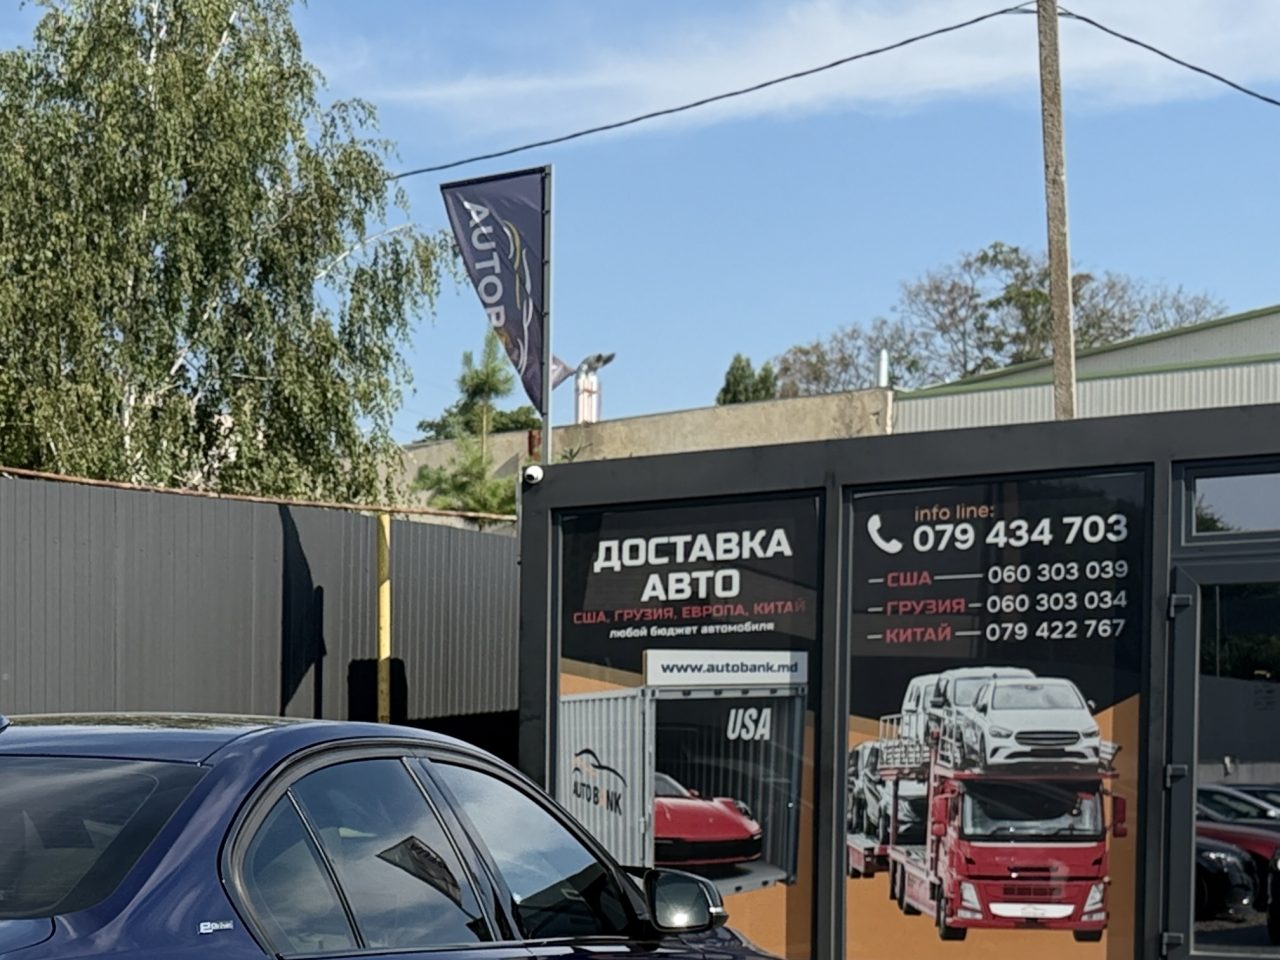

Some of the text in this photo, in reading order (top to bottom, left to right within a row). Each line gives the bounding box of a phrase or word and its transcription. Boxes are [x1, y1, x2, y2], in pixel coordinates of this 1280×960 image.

[914, 504, 996, 522] info line:
[913, 514, 1128, 552] 079 434 703
[593, 528, 793, 573] ДОСТАВКА
[640, 568, 741, 602] АВТО
[886, 559, 1128, 588] США 060 303 039
[573, 598, 806, 625] США, ГРУЗИЯ, ЕВРОПА, КИТАЙ
[886, 590, 1127, 617] ГРУЗИЯ 060 303 034
[885, 618, 1126, 643] КИТАЙ 079 422 767
[661, 661, 799, 674] www.autobank.md
[727, 707, 771, 741] USA
